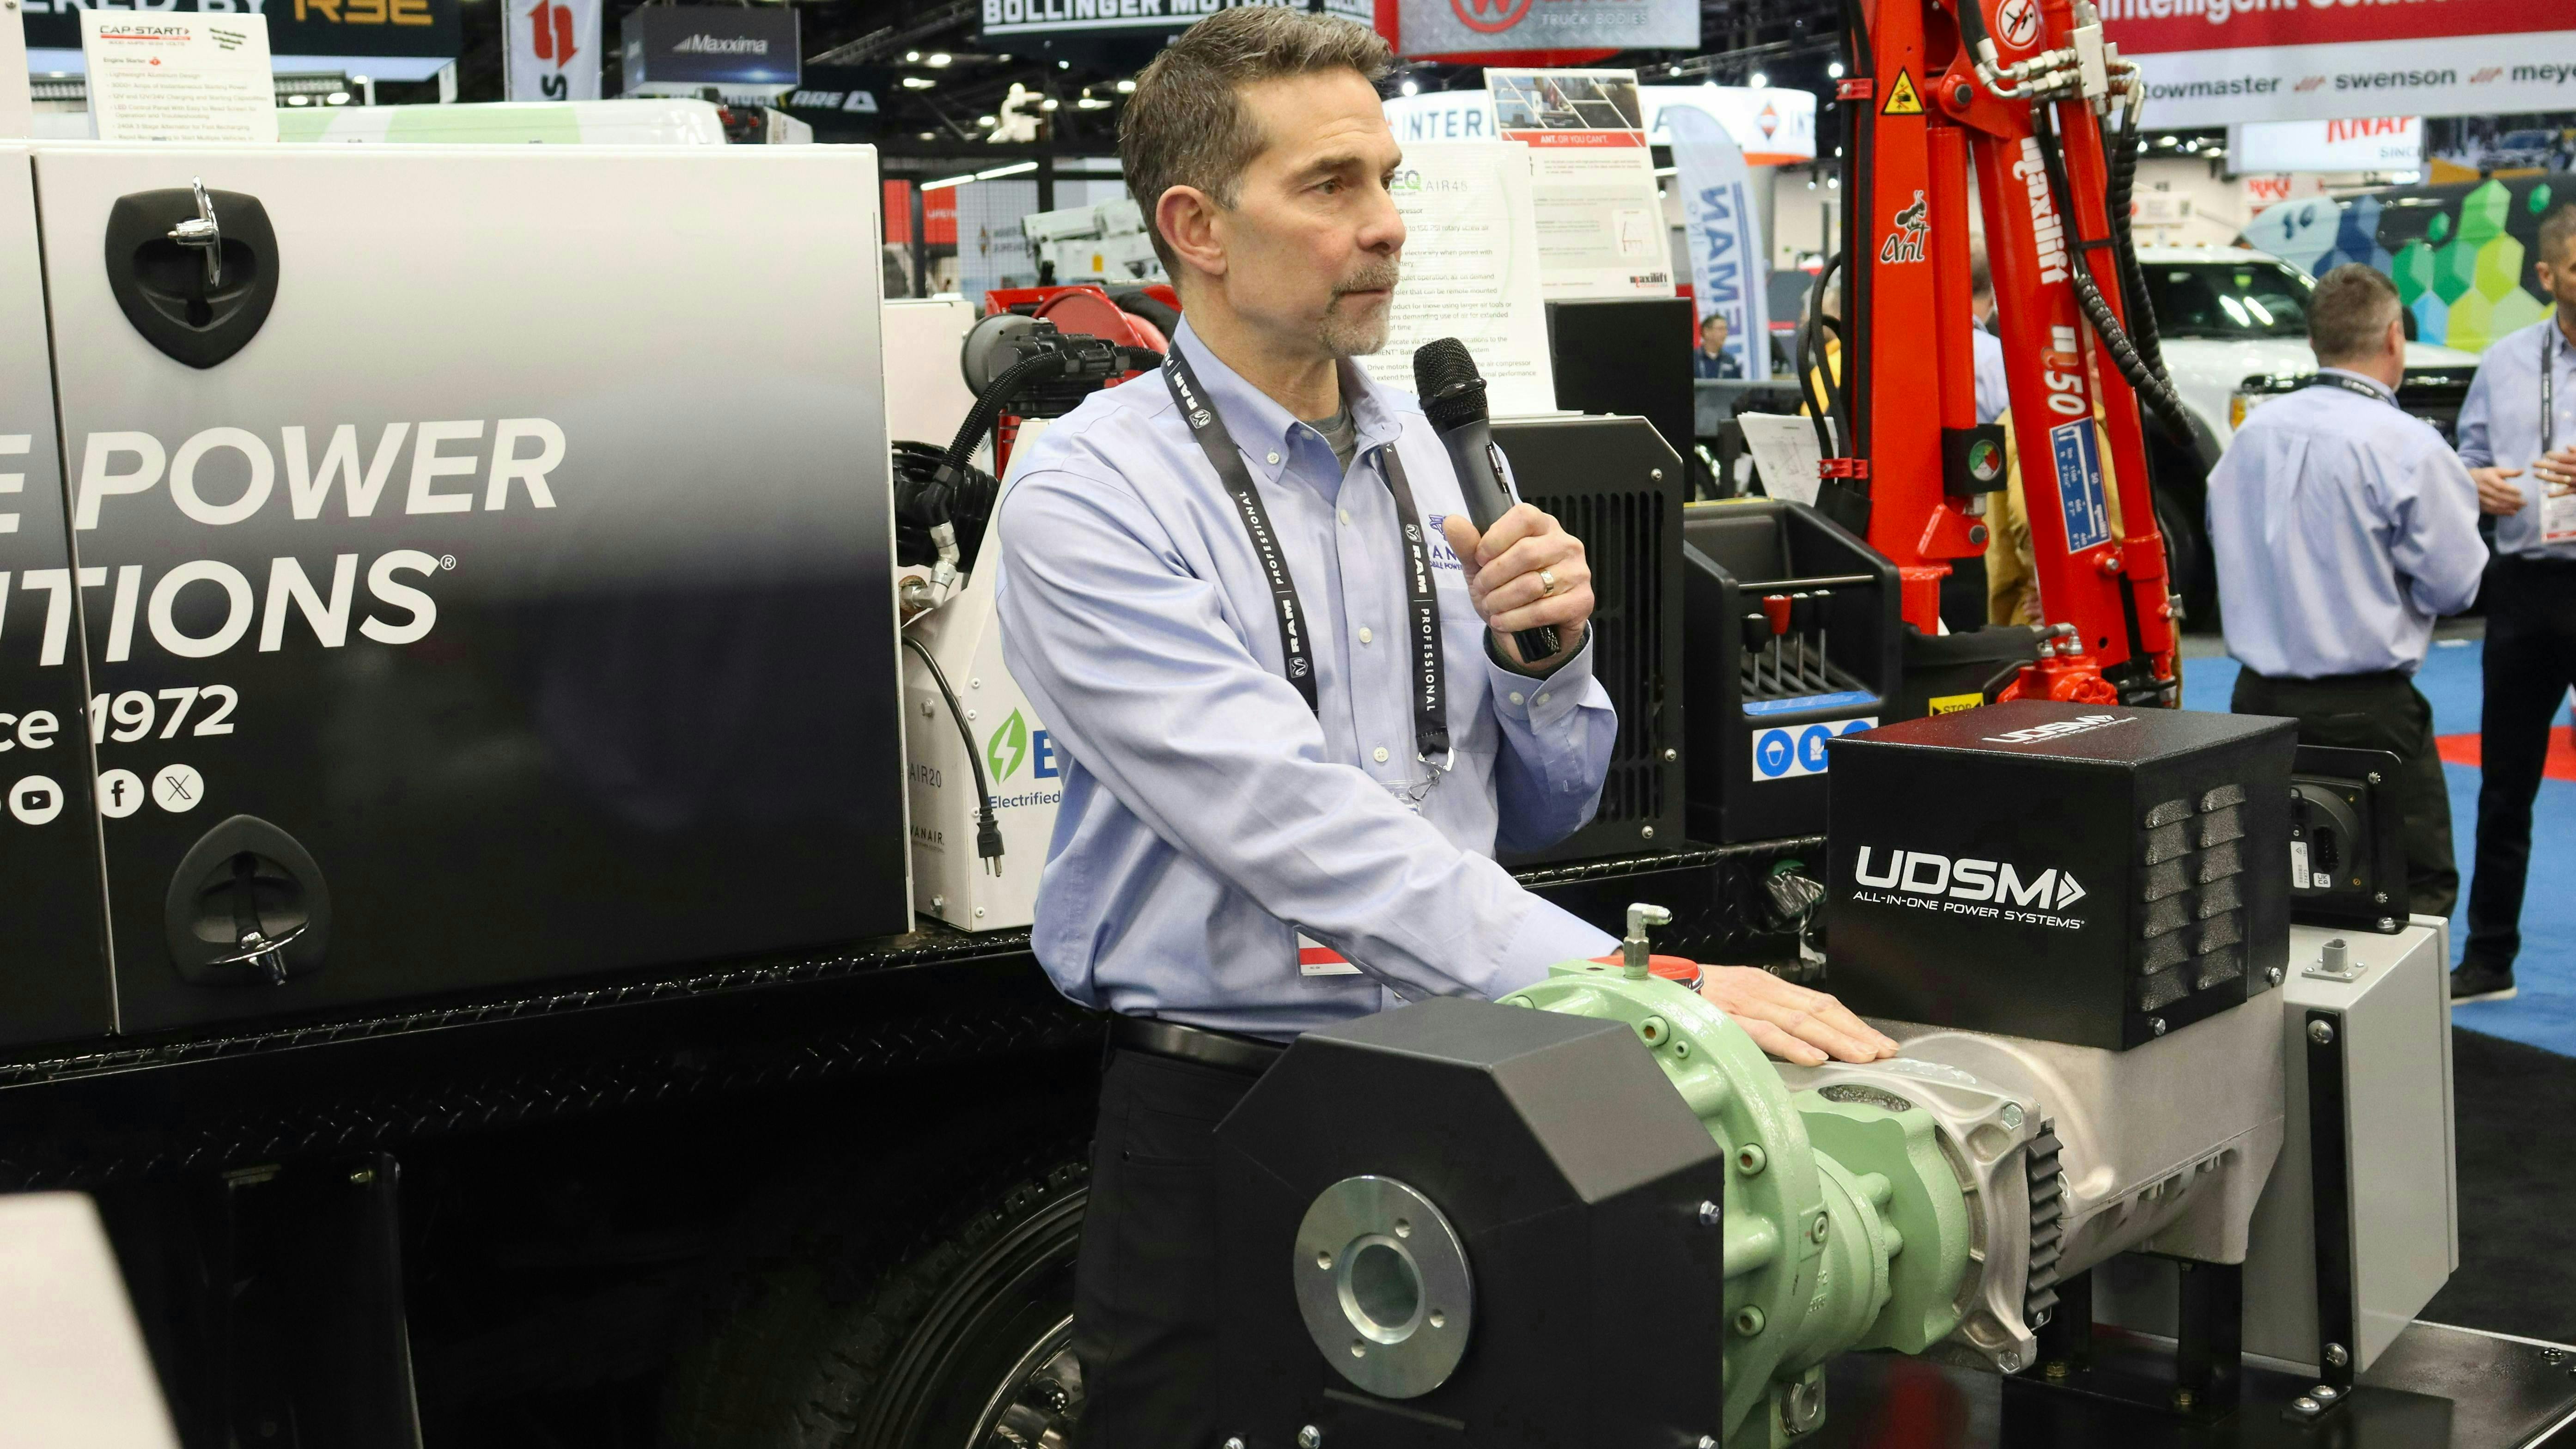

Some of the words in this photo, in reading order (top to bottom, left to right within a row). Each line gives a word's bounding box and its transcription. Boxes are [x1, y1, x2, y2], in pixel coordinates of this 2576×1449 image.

[1541, 12, 1589, 25] TRUCK
[1595, 12, 1647, 25] BODIES
[693, 34, 768, 55] Maxxima
[2143, 74, 2282, 100] towmaster
[2334, 66, 2456, 90] swenson
[1402, 108, 1497, 139] INTER
[2013, 136, 2069, 285] maxilift
[1881, 221, 1930, 262] Ant
[1630, 272, 1668, 288] maxilift
[1173, 371, 1199, 410] RAM
[75, 417, 566, 530] POWER
[1239, 491, 1285, 584] PROFESSIONAL
[1282, 599, 1300, 653] RAM
[1412, 544, 1428, 593] RAM
[1420, 608, 1436, 712] PROFESSIONAL
[80, 684, 239, 745] 1972
[1982, 714, 2111, 743] UDSM
[909, 763, 942, 788] AIR20
[988, 790, 1061, 810] Electrified
[1855, 845, 2058, 910] UDSM
[1852, 891, 1939, 911] ALL-IN-ONE
[1943, 902, 1999, 918] POWER
